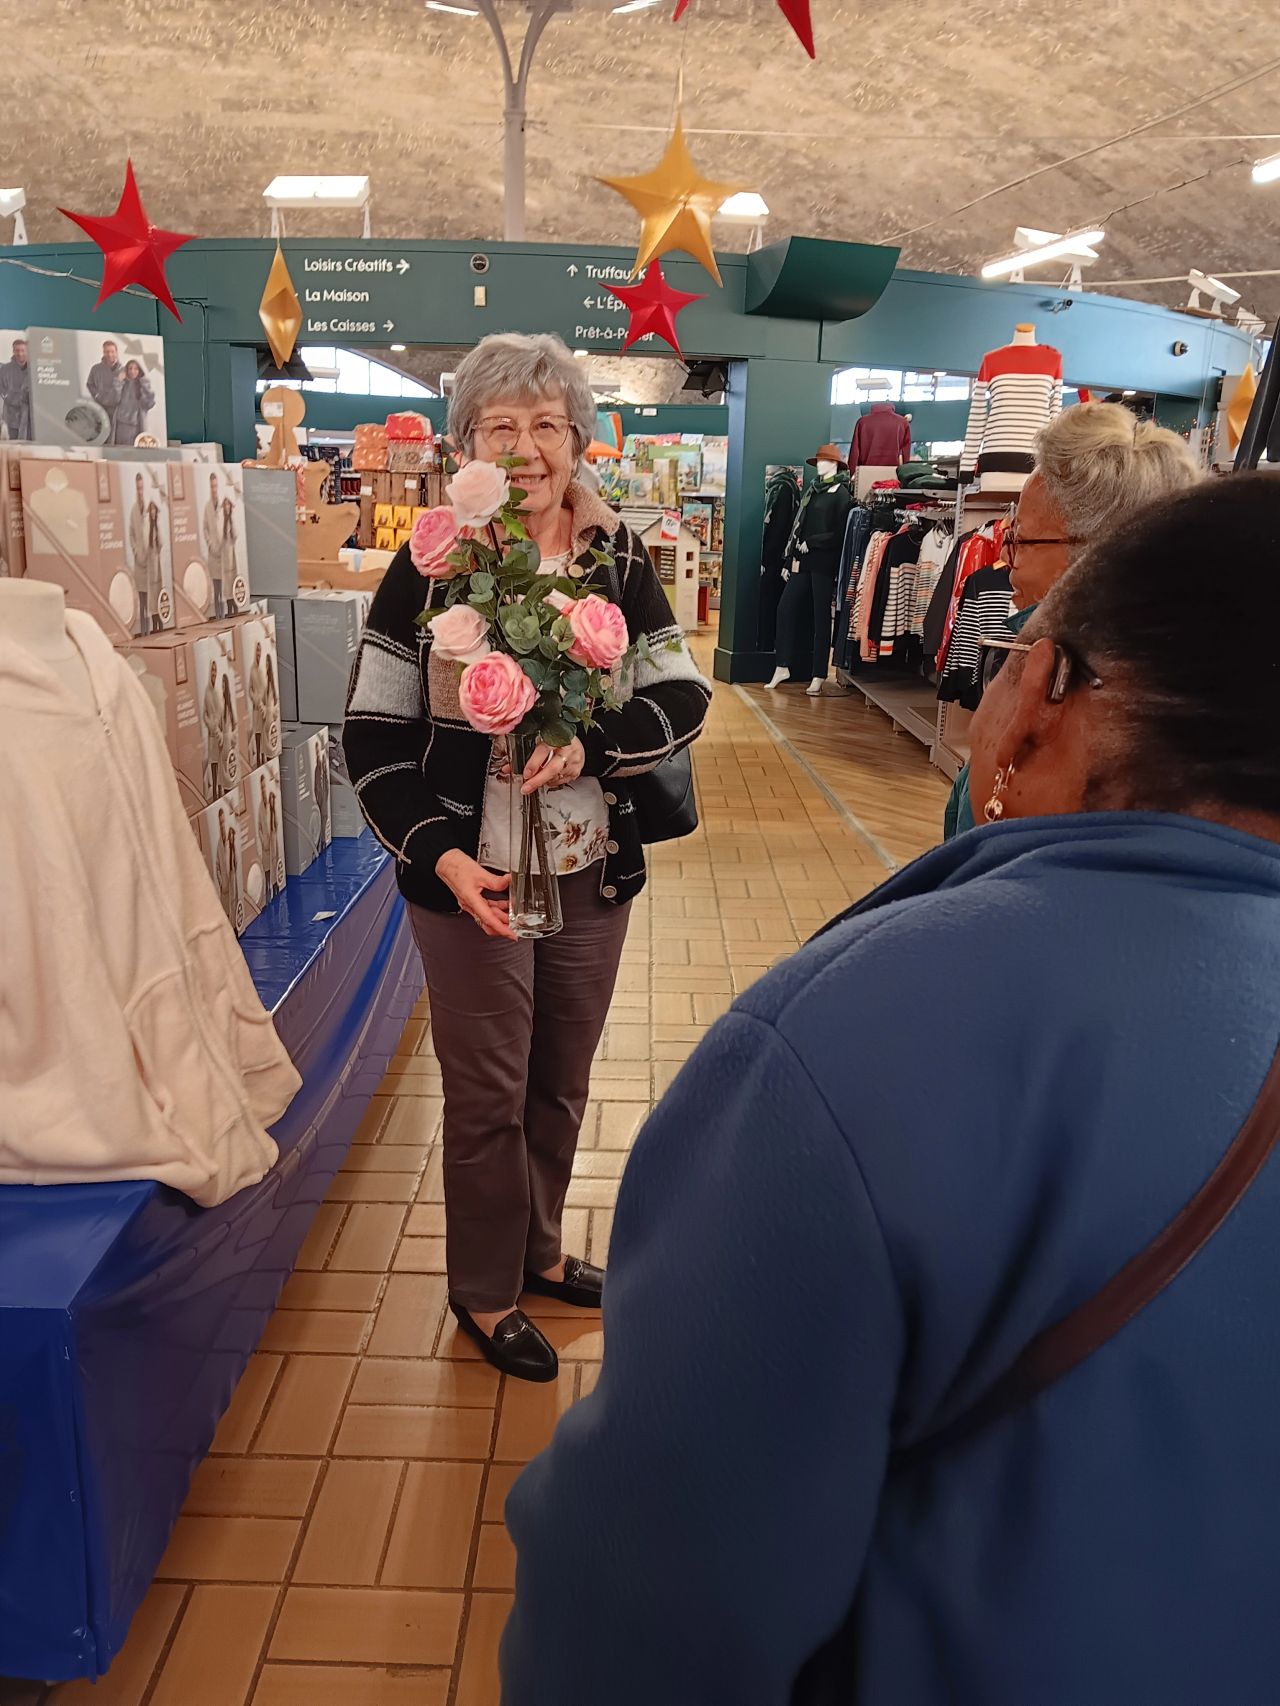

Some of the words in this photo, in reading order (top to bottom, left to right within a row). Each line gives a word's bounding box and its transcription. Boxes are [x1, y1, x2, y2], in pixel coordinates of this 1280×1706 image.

[304, 258, 342, 272] Loisirs
[344, 258, 394, 273] Créatifs
[585, 265, 632, 281] Truffau
[305, 289, 321, 302] La
[323, 289, 370, 302] Maison
[307, 318, 328, 332] Les
[330, 319, 376, 333] Caisses
[575, 326, 656, 342] Prêt-à-Per
